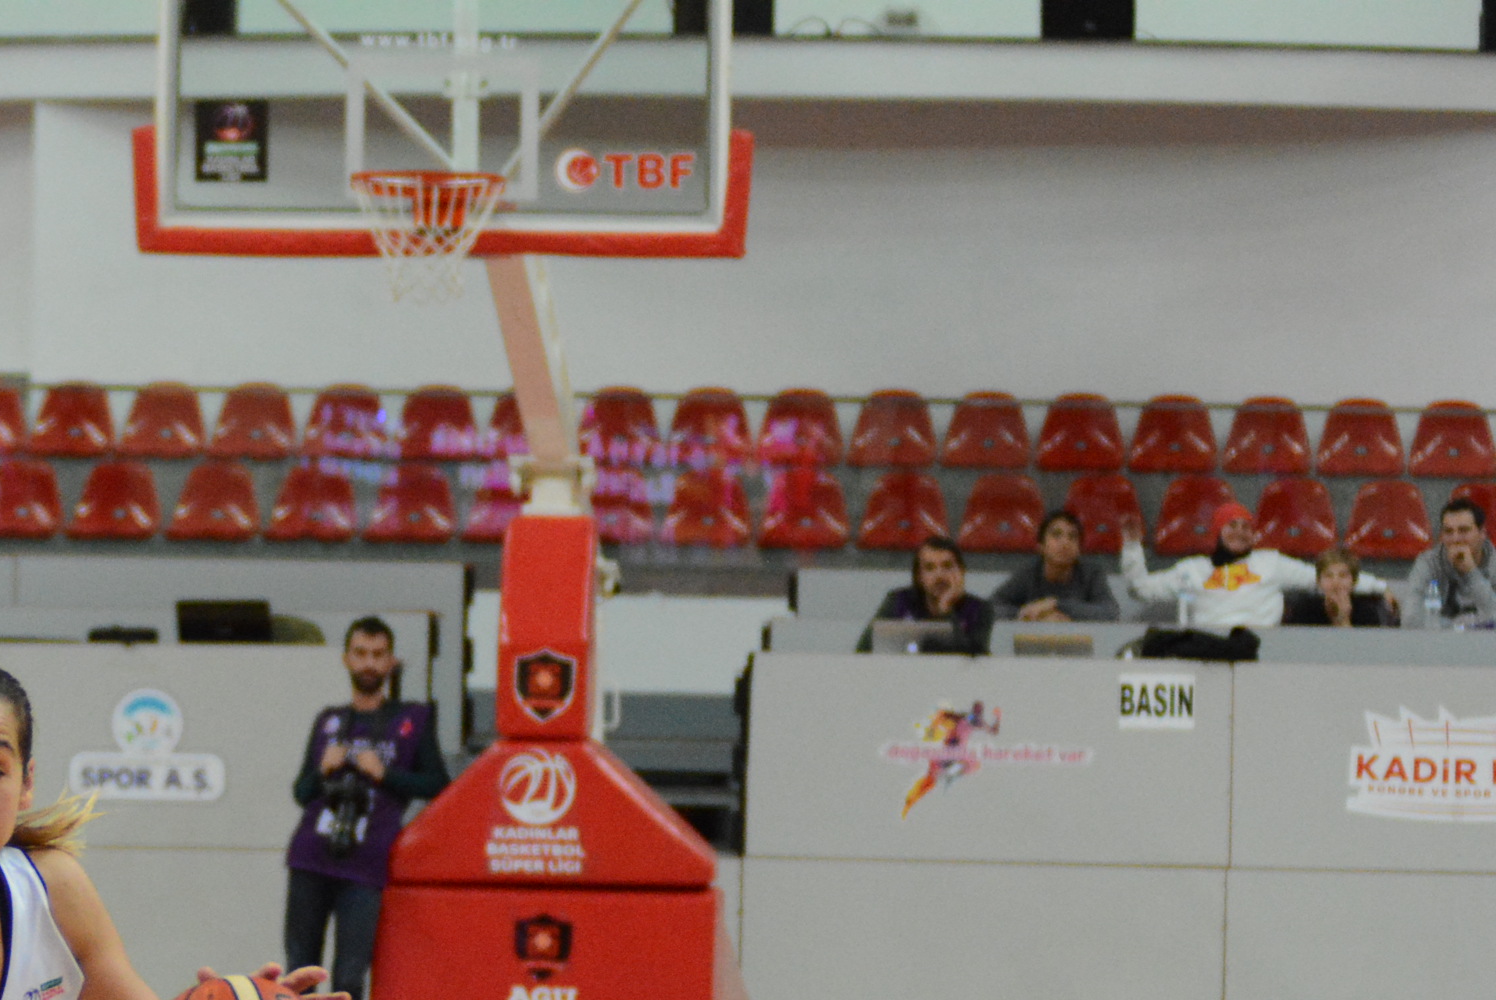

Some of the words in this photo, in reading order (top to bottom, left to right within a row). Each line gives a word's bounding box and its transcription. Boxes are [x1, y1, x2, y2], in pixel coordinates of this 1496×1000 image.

[604, 153, 694, 189] TBF
[1120, 682, 1194, 717] BASIN
[81, 766, 152, 791] SPOR
